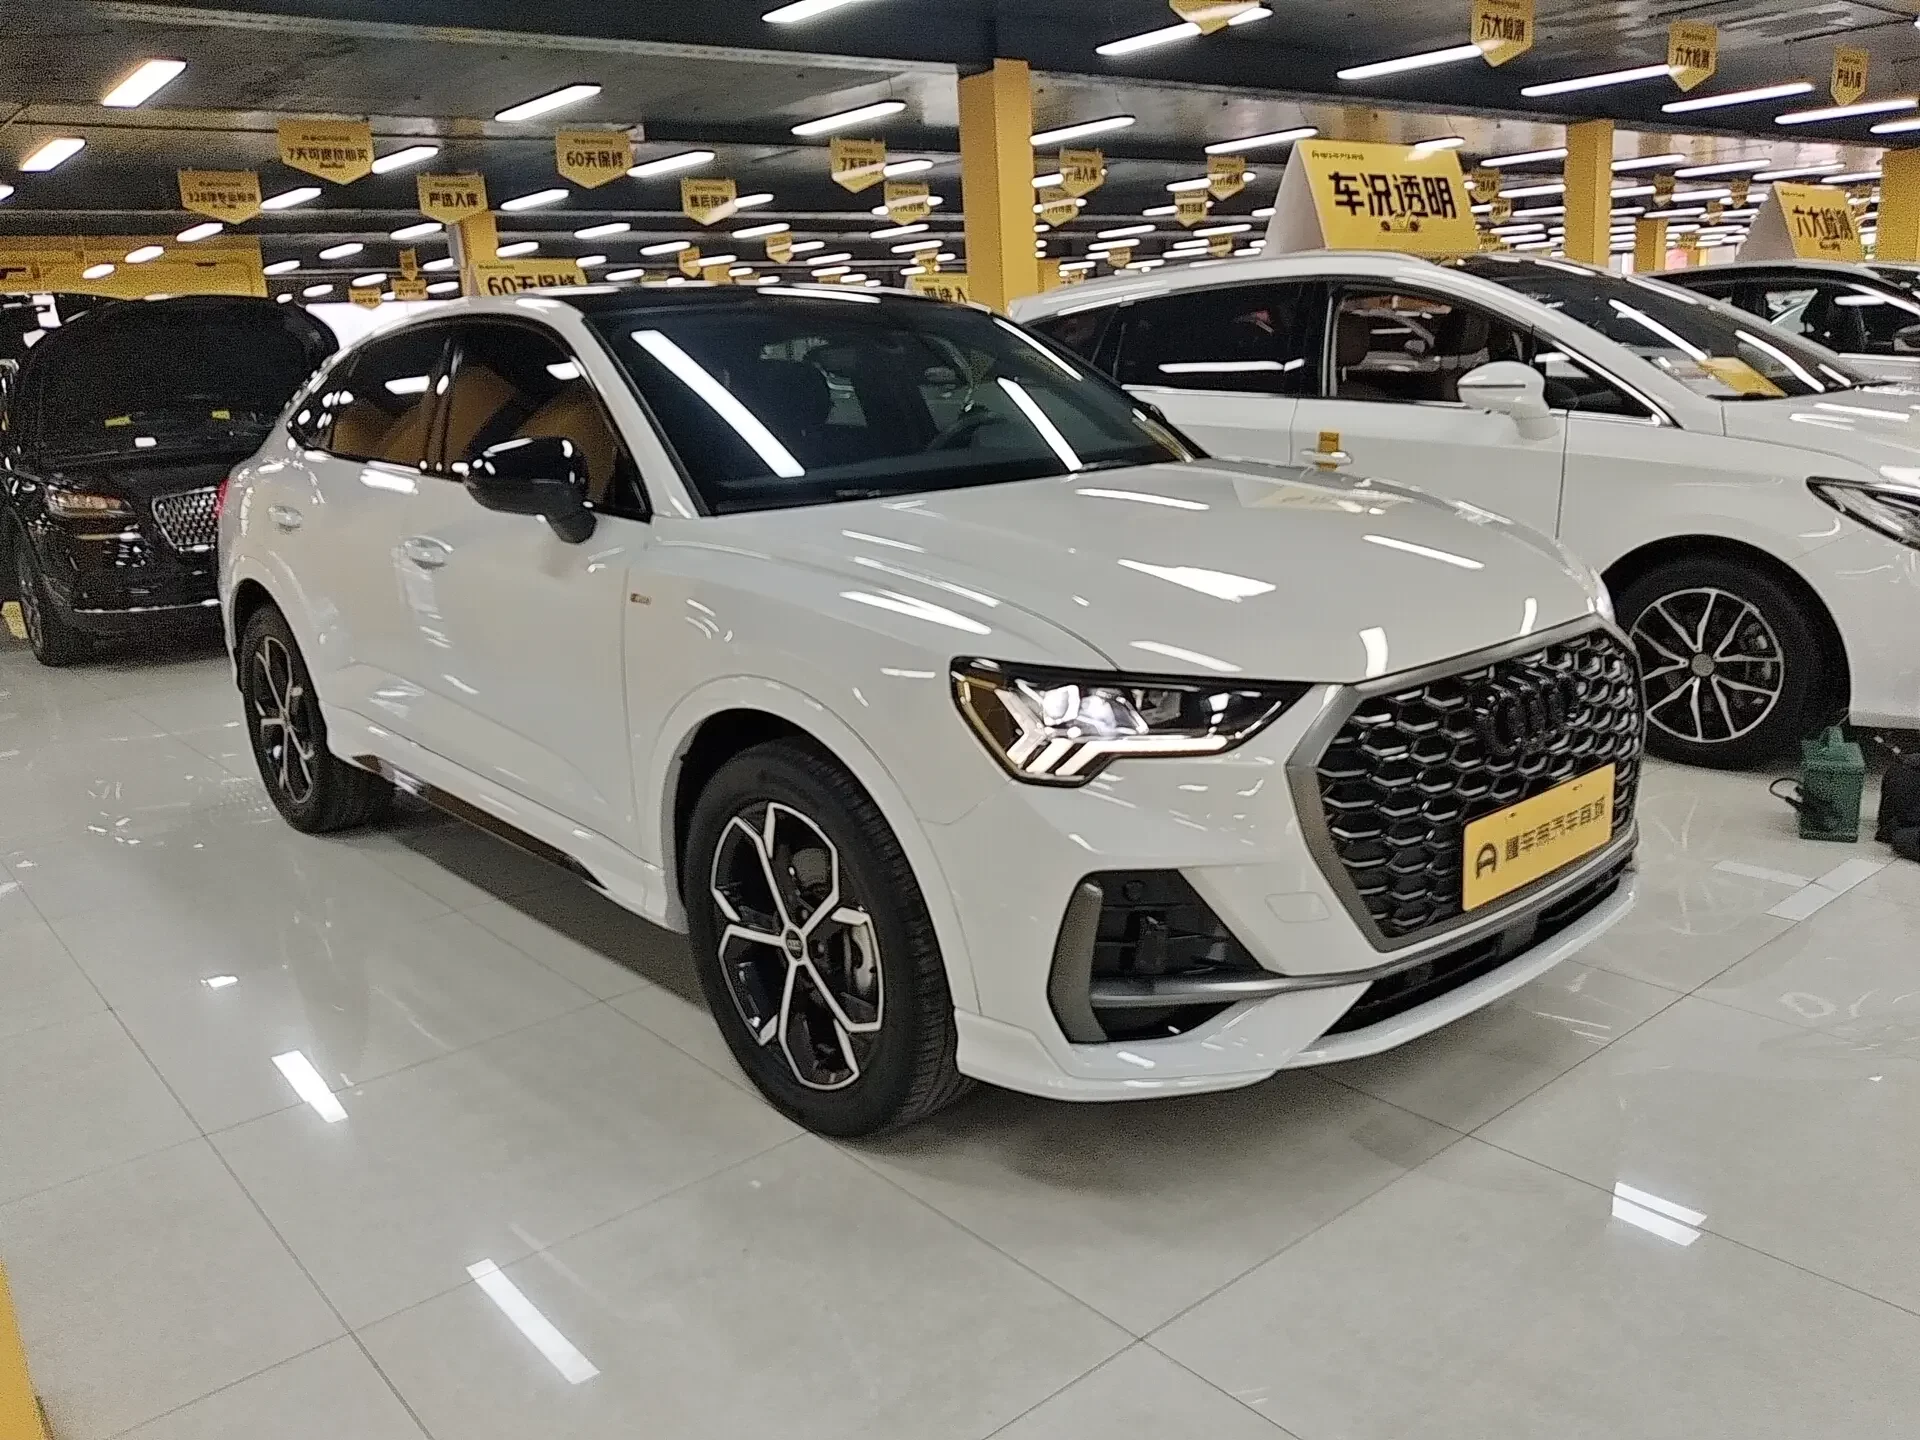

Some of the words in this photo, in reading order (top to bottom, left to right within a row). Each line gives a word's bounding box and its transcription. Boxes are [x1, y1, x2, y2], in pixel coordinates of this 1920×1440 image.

[1481, 13, 1525, 41] 六大检测
[1675, 43, 1711, 69] 六大检测
[566, 150, 624, 168] 60天保修
[428, 191, 478, 208] 严选入库
[1328, 171, 1456, 219] 车况透明
[1792, 204, 1854, 241] 六大检测
